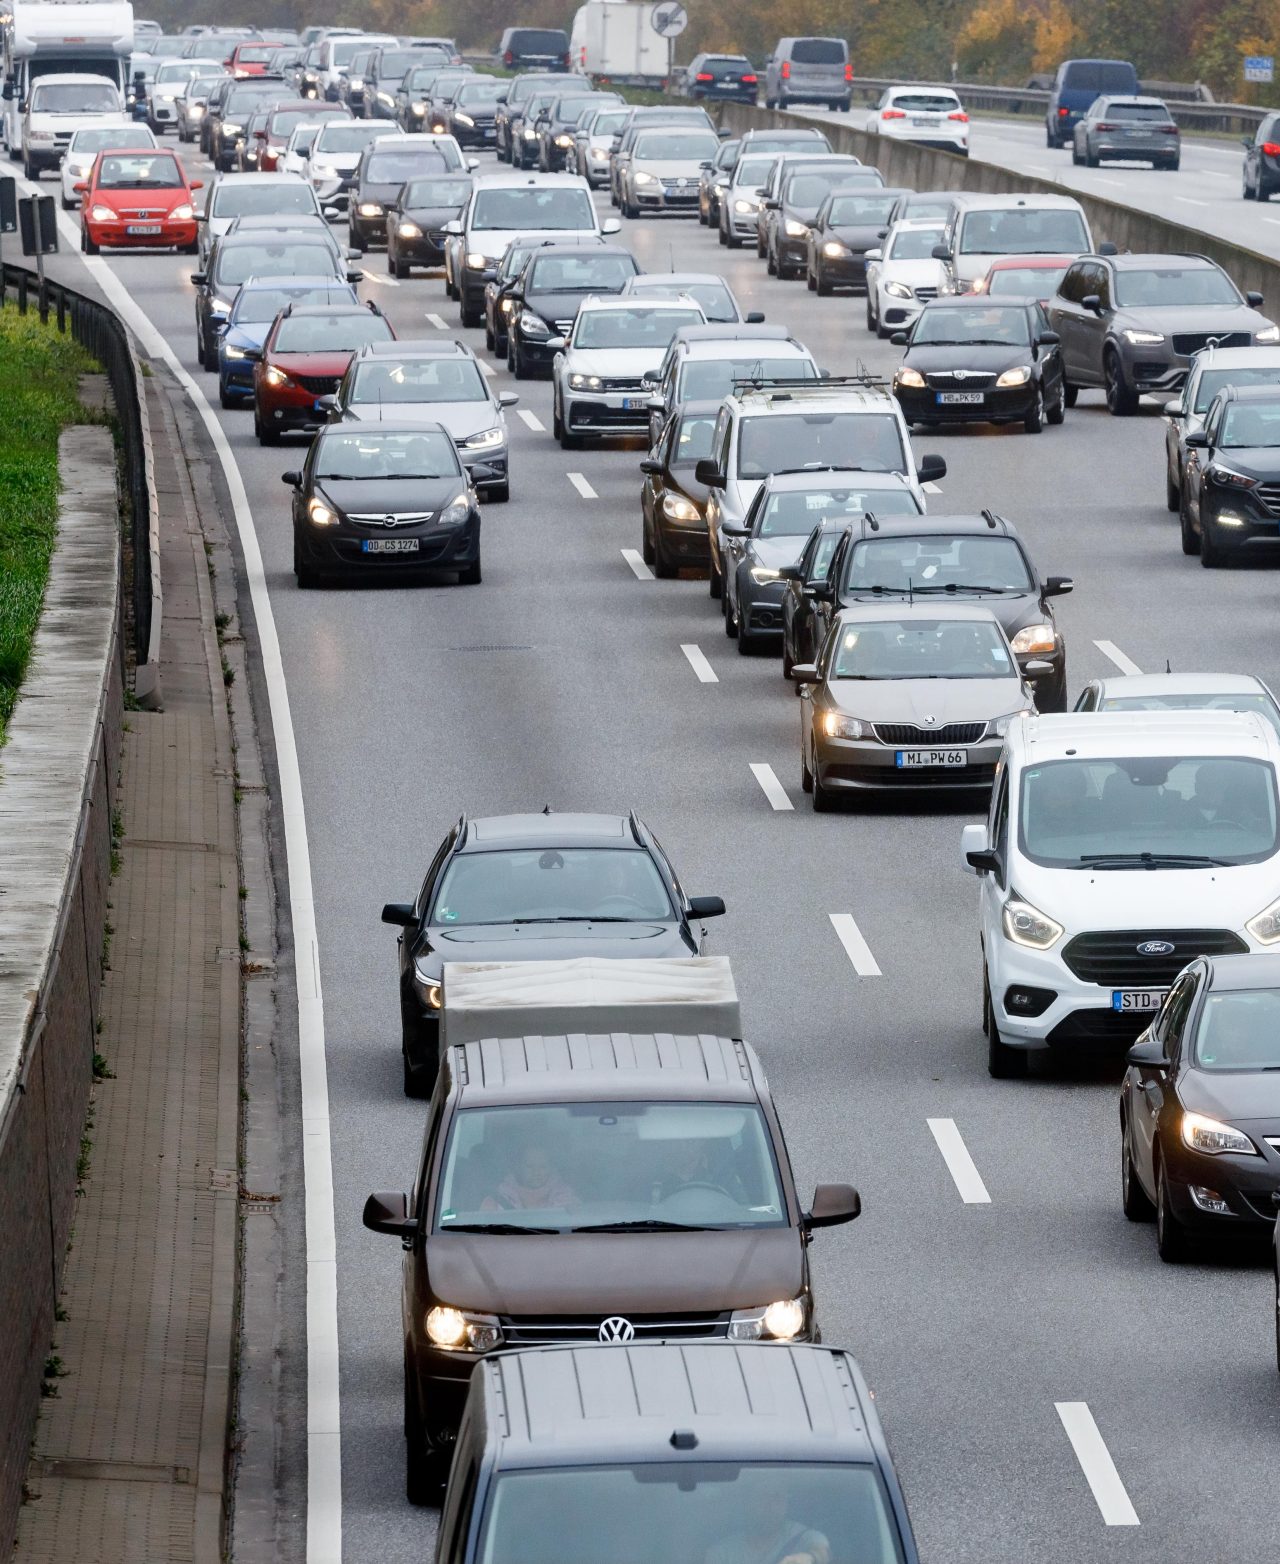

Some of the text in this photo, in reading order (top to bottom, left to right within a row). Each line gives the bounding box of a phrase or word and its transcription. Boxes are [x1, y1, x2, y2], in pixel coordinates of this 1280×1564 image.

[385, 540, 396, 550] CS
[398, 540, 418, 550] 1274
[907, 751, 962, 764] MI PW 66
[1144, 943, 1166, 952] Ford
[1122, 993, 1151, 1008] STD
